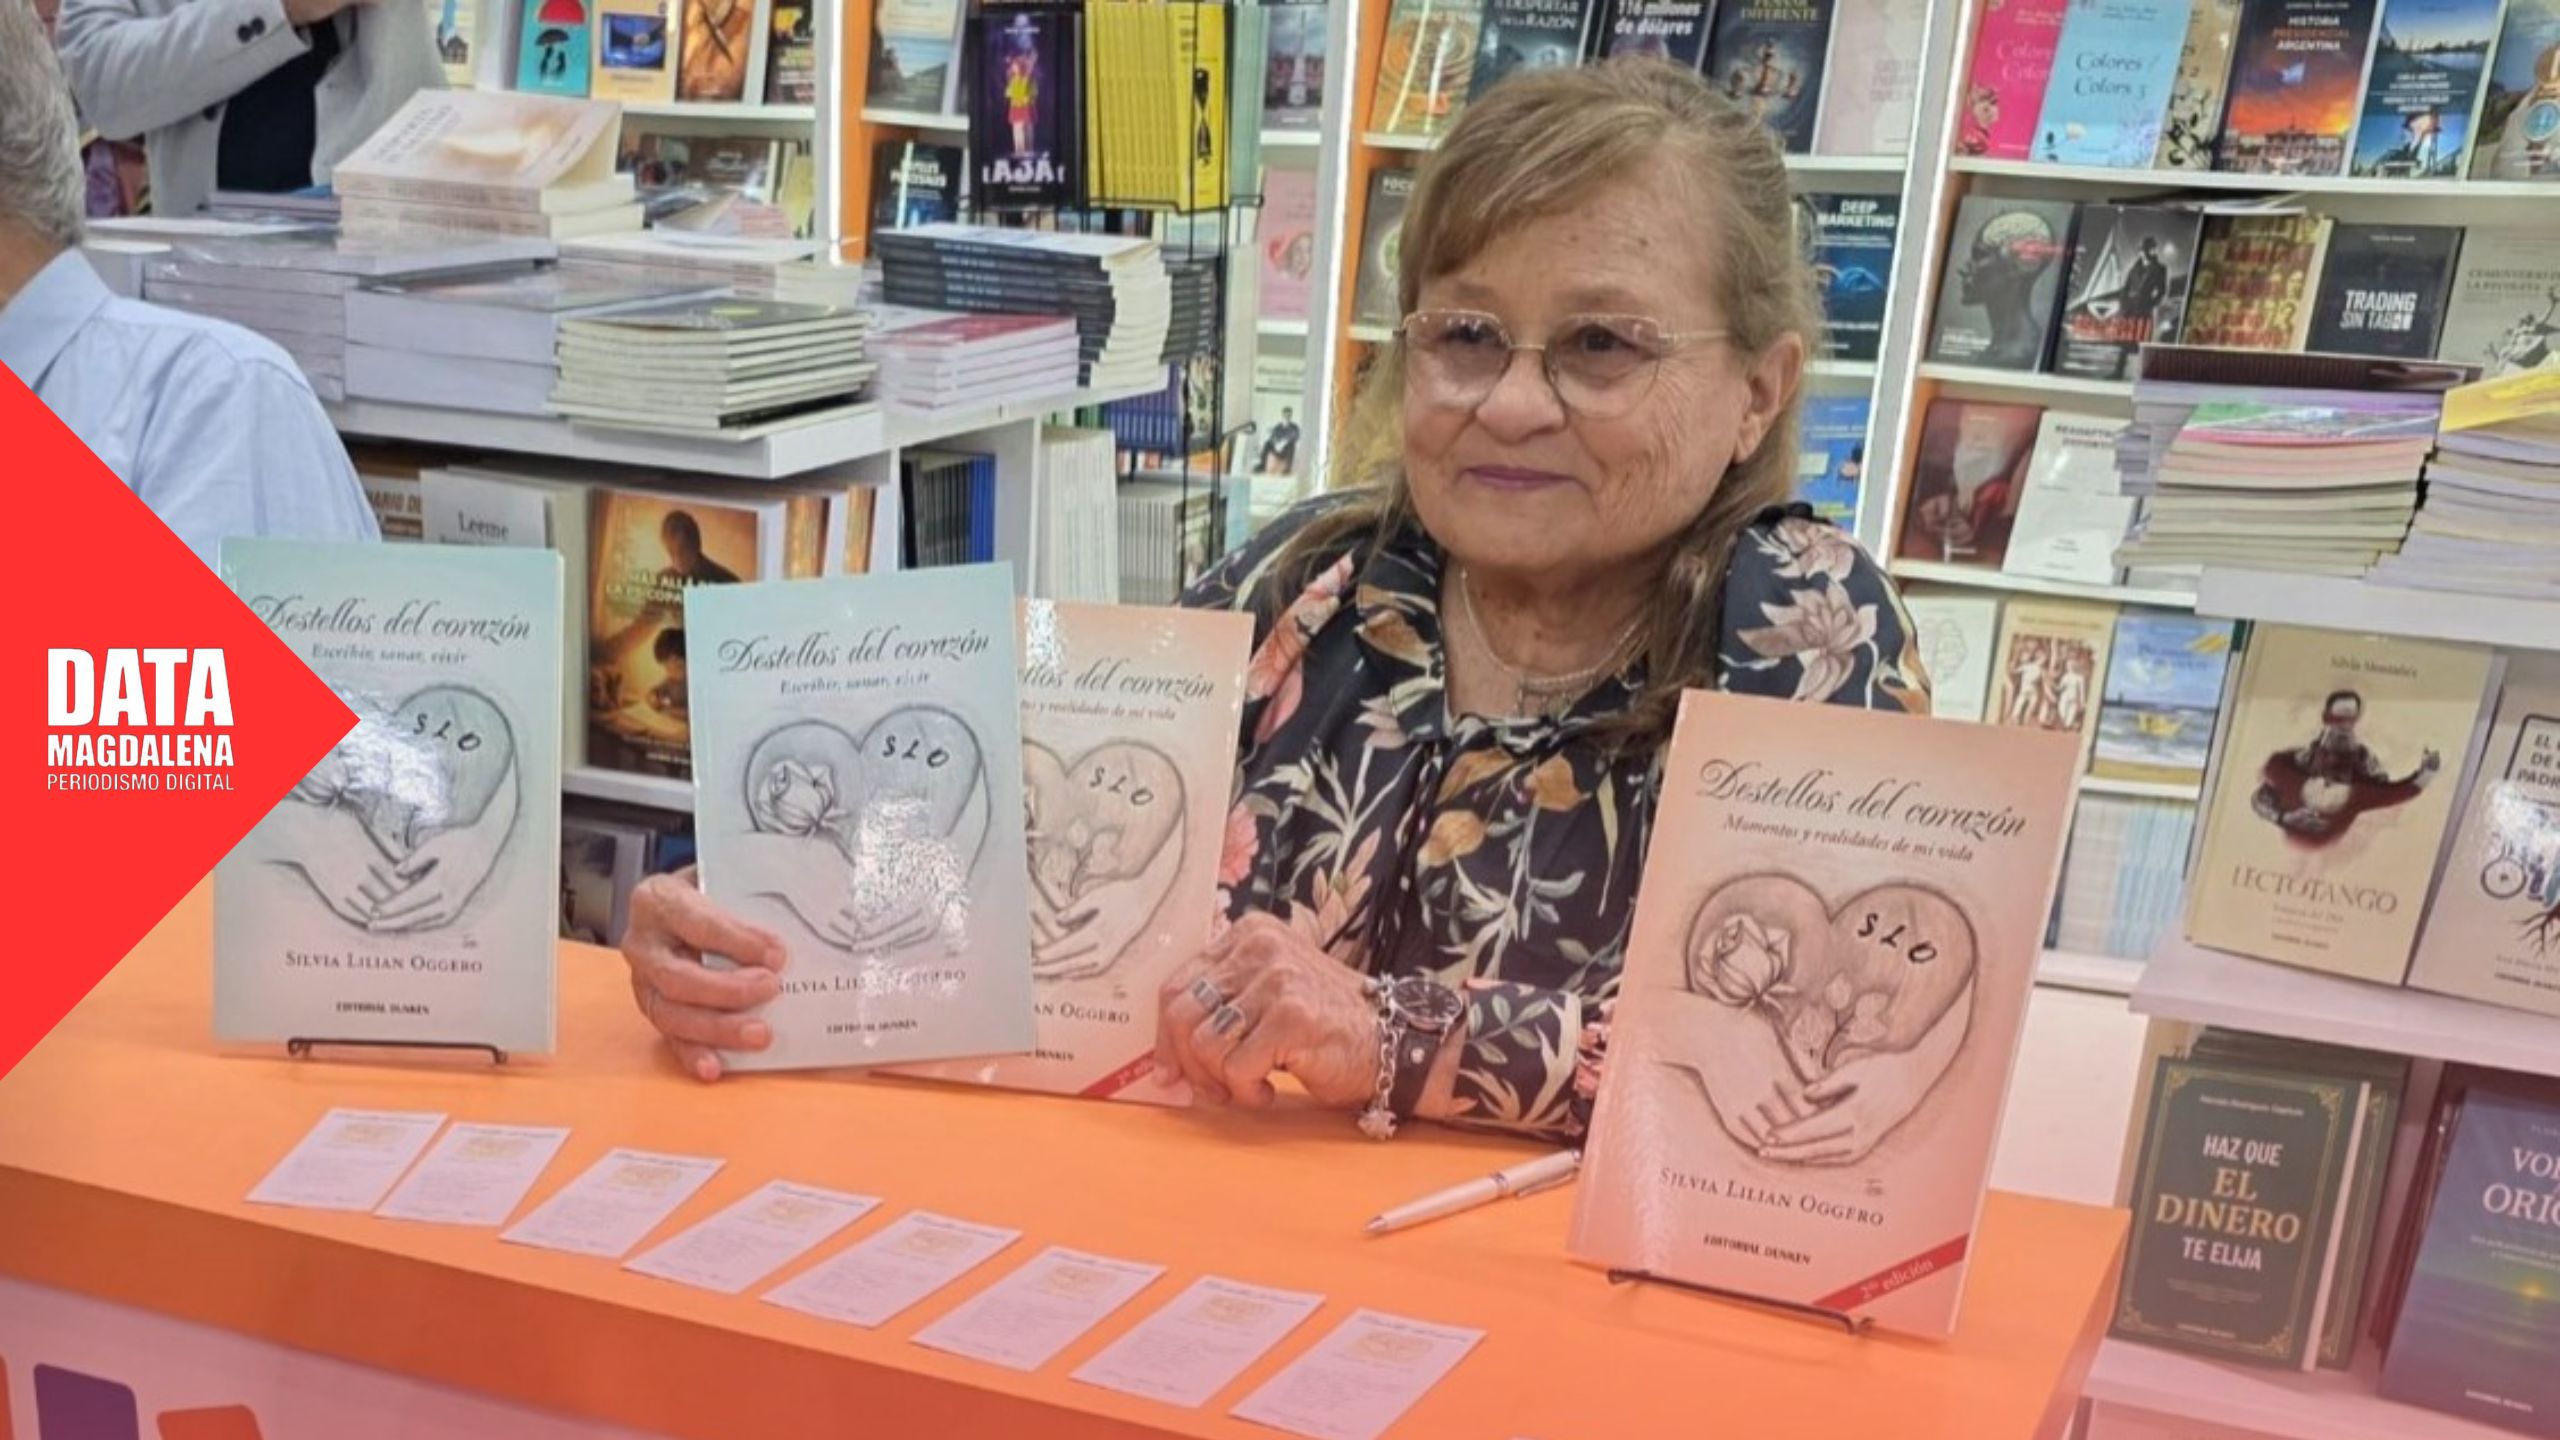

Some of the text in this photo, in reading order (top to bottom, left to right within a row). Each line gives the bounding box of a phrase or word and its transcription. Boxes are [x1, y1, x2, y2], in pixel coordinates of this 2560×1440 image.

[1614, 18, 1694, 36] de dólares
[2276, 40, 2341, 51] ARGENTINA
[1816, 213, 1896, 228] MARKETING
[1840, 200, 1879, 214] DEEP
[2345, 289, 2419, 313] TRADING
[2338, 311, 2366, 331] SIN
[249, 595, 531, 647] Destellos del corazón
[717, 624, 991, 674] Destellos del corazón
[1073, 656, 1130, 690] del
[1119, 673, 1215, 703] corazón
[1696, 758, 2028, 843] Destellos del corazón
[1724, 813, 1974, 864] Momentos y realidades de mi vida
[2231, 865, 2399, 915] LECTOTANGO
[285, 950, 483, 973] SILVIA LILIAN OGGERO
[1060, 1002, 1130, 1023] OGGERO
[2202, 1133, 2284, 1168] HAZ QUE
[1659, 1166, 1885, 1228] SILVIA LILIAN OGGERO
[2213, 1166, 2258, 1202] EL
[2155, 1193, 2302, 1243] DINERO
[1703, 1233, 1812, 1266] EDITORIAL DUNKEN
[2182, 1236, 2263, 1271] TE ELIJA
[1881, 1257, 1935, 1292] edición
